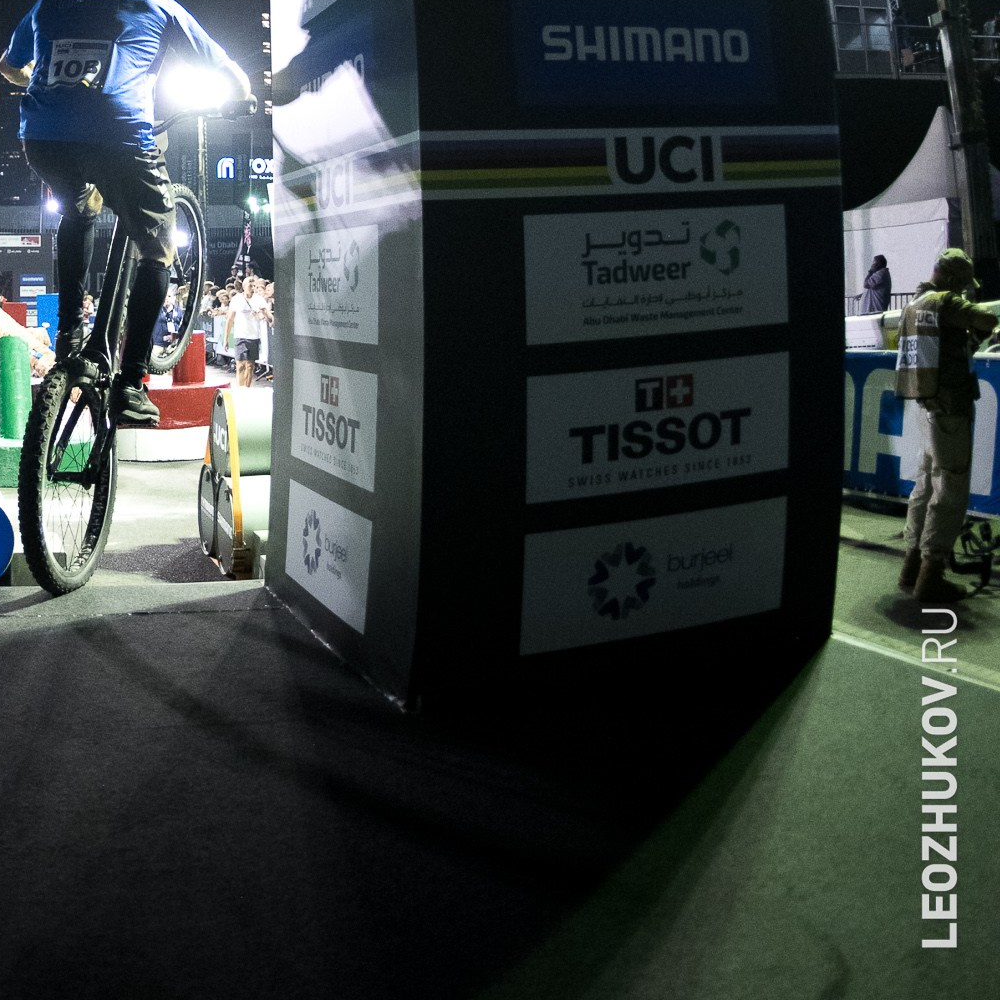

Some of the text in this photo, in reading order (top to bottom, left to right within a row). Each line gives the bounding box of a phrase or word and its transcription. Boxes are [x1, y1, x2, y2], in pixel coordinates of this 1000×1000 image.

[542, 24, 750, 63] SHIMANO
[613, 135, 715, 185] UCI
[316, 160, 352, 211] UCI
[308, 271, 341, 293] Tadweer
[581, 259, 691, 286] Tadweer
[583, 316, 601, 326] Abu
[602, 313, 629, 324] Dhabi
[630, 312, 659, 322] Waste
[303, 404, 360, 453] TISSOT
[569, 407, 752, 464] TISSOT
[568, 473, 611, 488] SWISS
[618, 465, 678, 482] WATCHES
[684, 458, 721, 473] SINCE
[667, 543, 733, 573] burjeel
